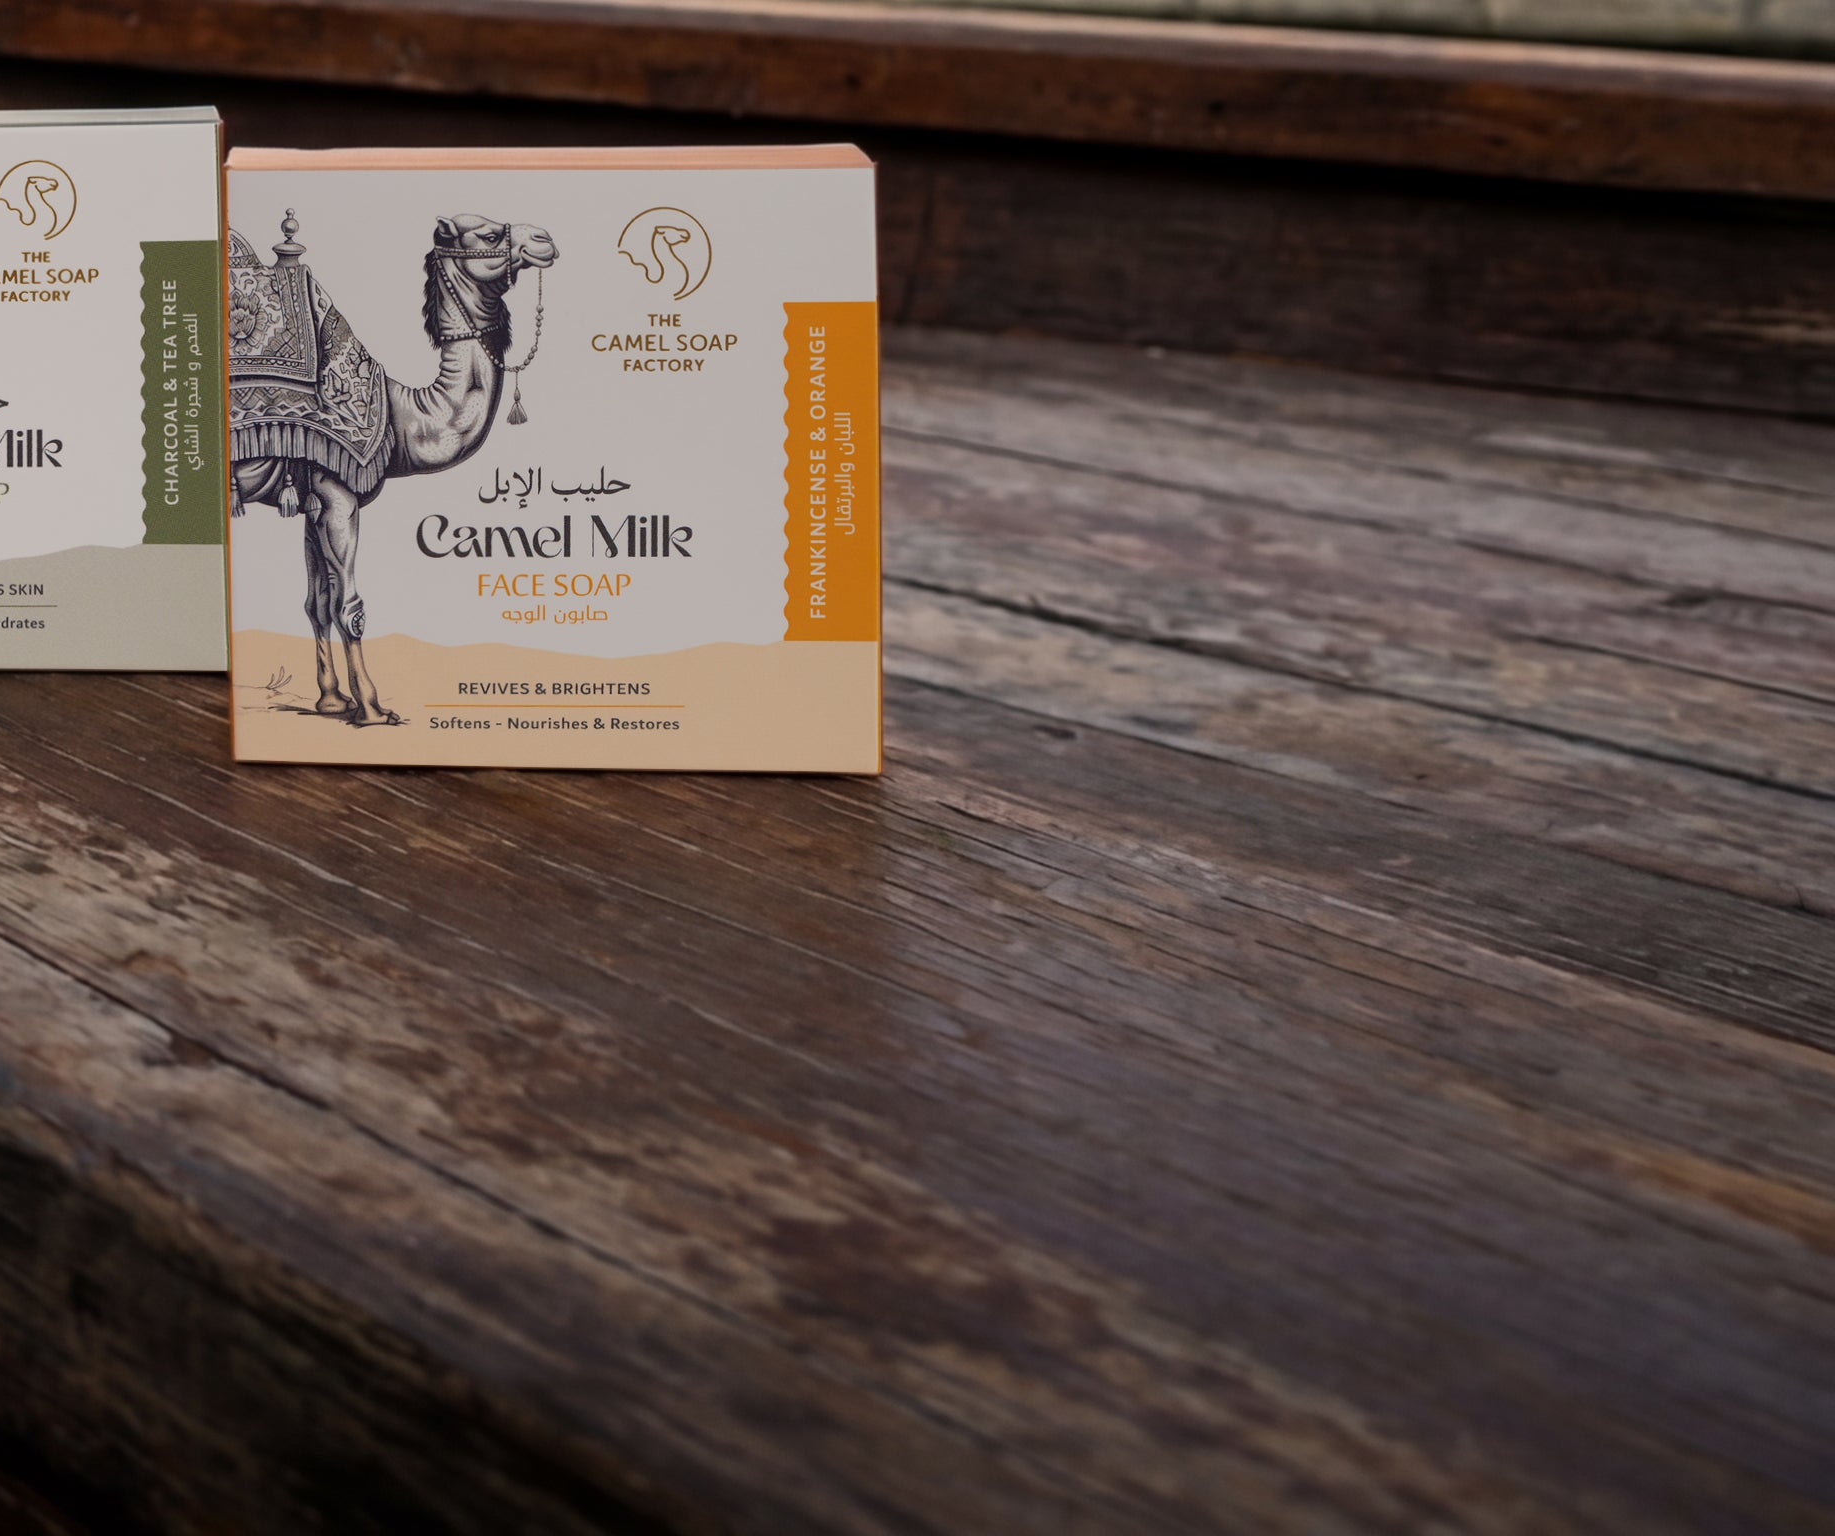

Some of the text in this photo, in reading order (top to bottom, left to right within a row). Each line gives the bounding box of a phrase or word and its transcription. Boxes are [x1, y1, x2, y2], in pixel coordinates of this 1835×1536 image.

[21, 251, 51, 263] THE
[46, 268, 99, 284] SOAP
[0, 290, 71, 302] FACTORY
[647, 314, 681, 327] THE
[591, 334, 738, 352] CAMEL SOAP
[623, 359, 704, 372] FACTORY
[163, 280, 179, 505] CHARCOAL & TEA TREE
[183, 313, 204, 470] الفحم و شجرة الشاي
[809, 326, 826, 619] FRANKINCENSE & ORANGE
[834, 412, 855, 536] اللبان والبرتقال
[478, 465, 631, 510] حليب الإبل
[416, 514, 693, 559] Camel Milk
[9, 584, 44, 596] SKIN
[478, 573, 631, 597] FACE SOAP
[501, 604, 608, 624] صابون الوجه
[458, 682, 651, 695] REVIVES & BRIGHTENS
[429, 716, 491, 730] Softens
[508, 717, 588, 730] Nourishes
[593, 718, 605, 730] &
[610, 718, 680, 730] Restores
